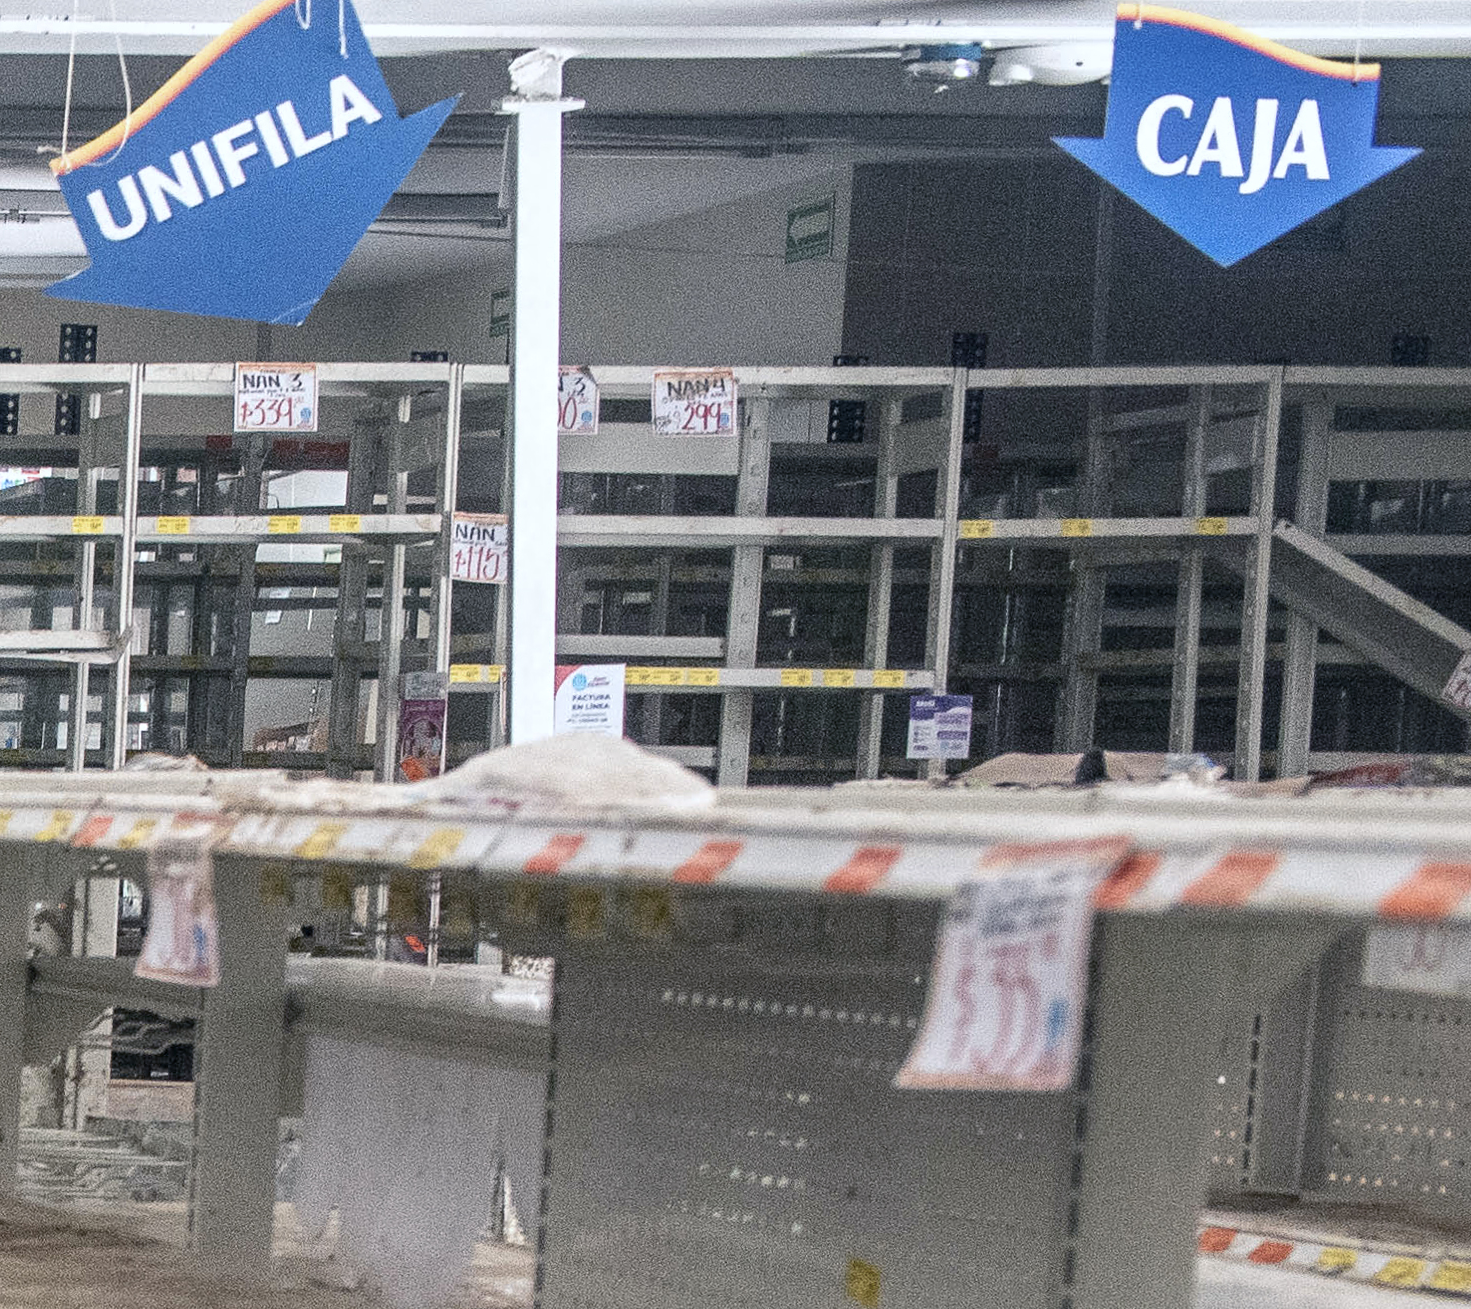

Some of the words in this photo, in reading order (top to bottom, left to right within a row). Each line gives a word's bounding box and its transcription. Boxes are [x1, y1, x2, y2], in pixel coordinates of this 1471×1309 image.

[1135, 93, 1330, 195] CAJA
[85, 73, 383, 243] UNIFILA
[243, 373, 281, 389] NAN
[289, 373, 303, 388] 3
[667, 378, 710, 397] NAN
[456, 523, 496, 542] NAN
